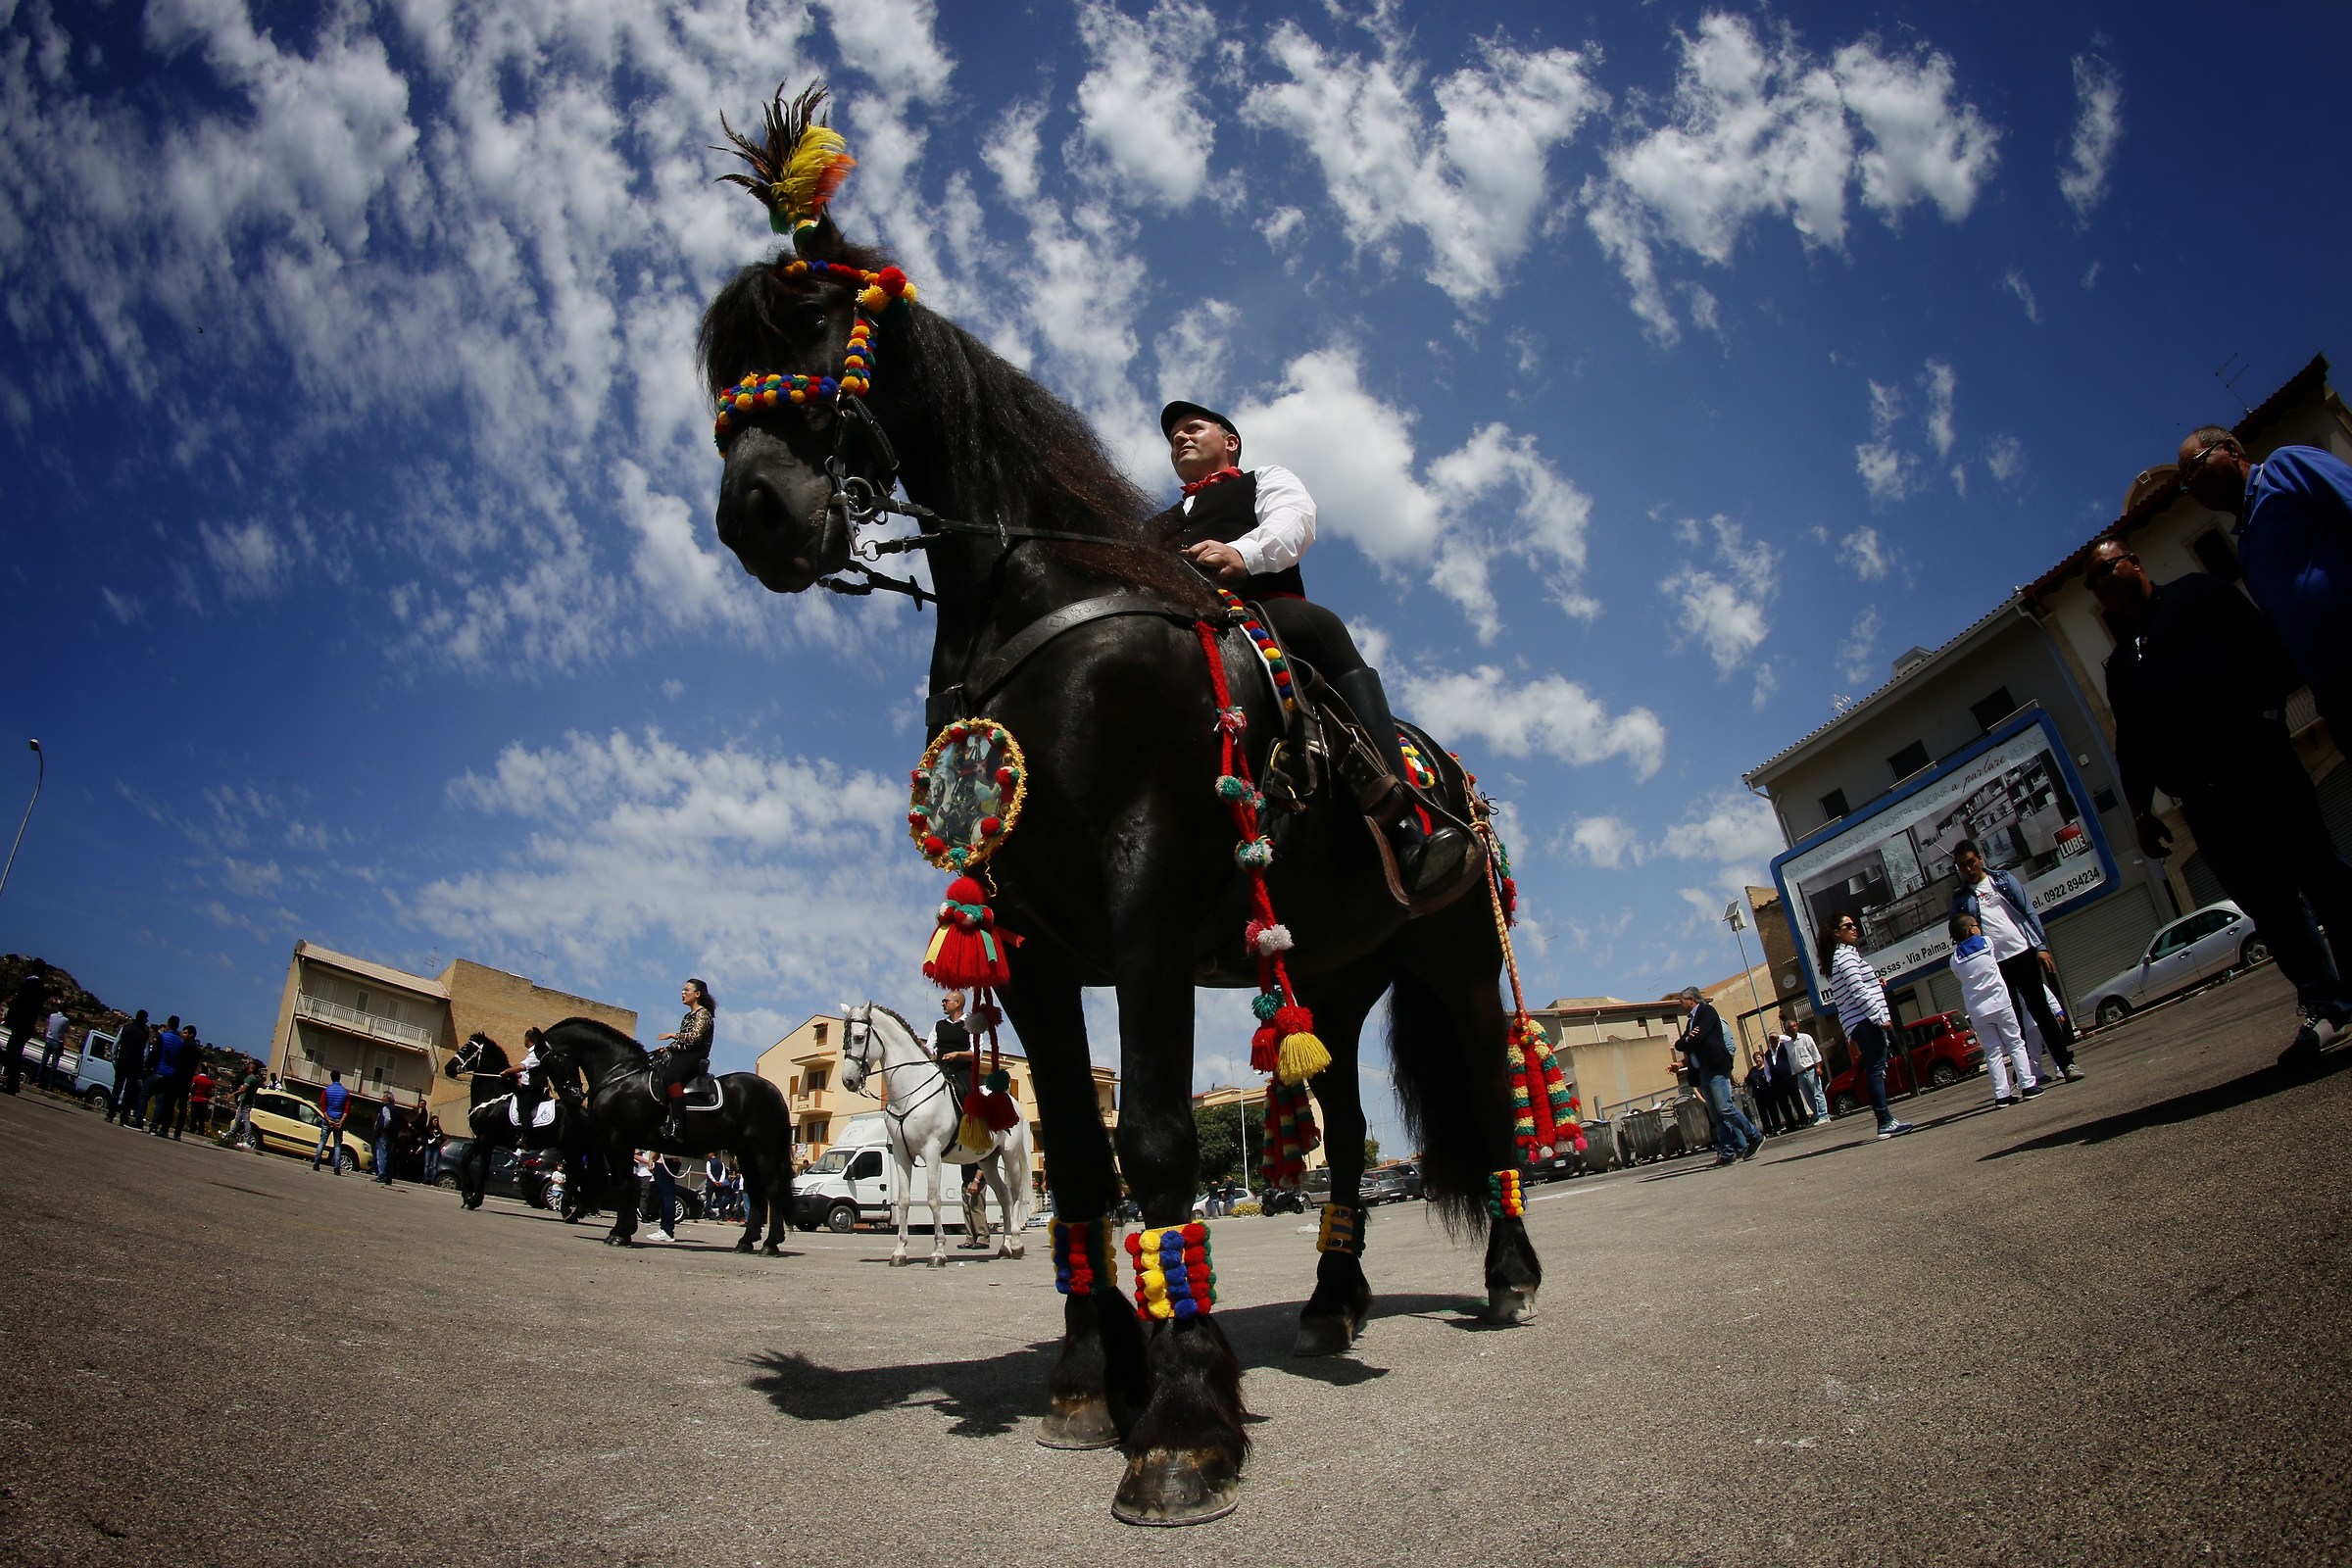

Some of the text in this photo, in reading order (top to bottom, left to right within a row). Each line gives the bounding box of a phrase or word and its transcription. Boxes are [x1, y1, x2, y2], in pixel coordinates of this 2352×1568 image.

[1788, 865, 1803, 878] DA
[1815, 848, 1837, 864] ANNI
[1837, 831, 1866, 853] SONO
[1865, 823, 1879, 840] LE
[1879, 807, 1915, 831] NOSTRE
[1915, 786, 1949, 811] CUCINE
[1951, 783, 1958, 792] a
[1962, 755, 2005, 797] parlare
[2009, 742, 2027, 760] PER
[2059, 833, 2086, 858] LUBE
[1906, 953, 1921, 964] Via
[1921, 941, 1950, 958] Palma,
[2032, 896, 2044, 909] el.
[2044, 884, 2067, 903] 0922
[2067, 866, 2100, 892] 894234
